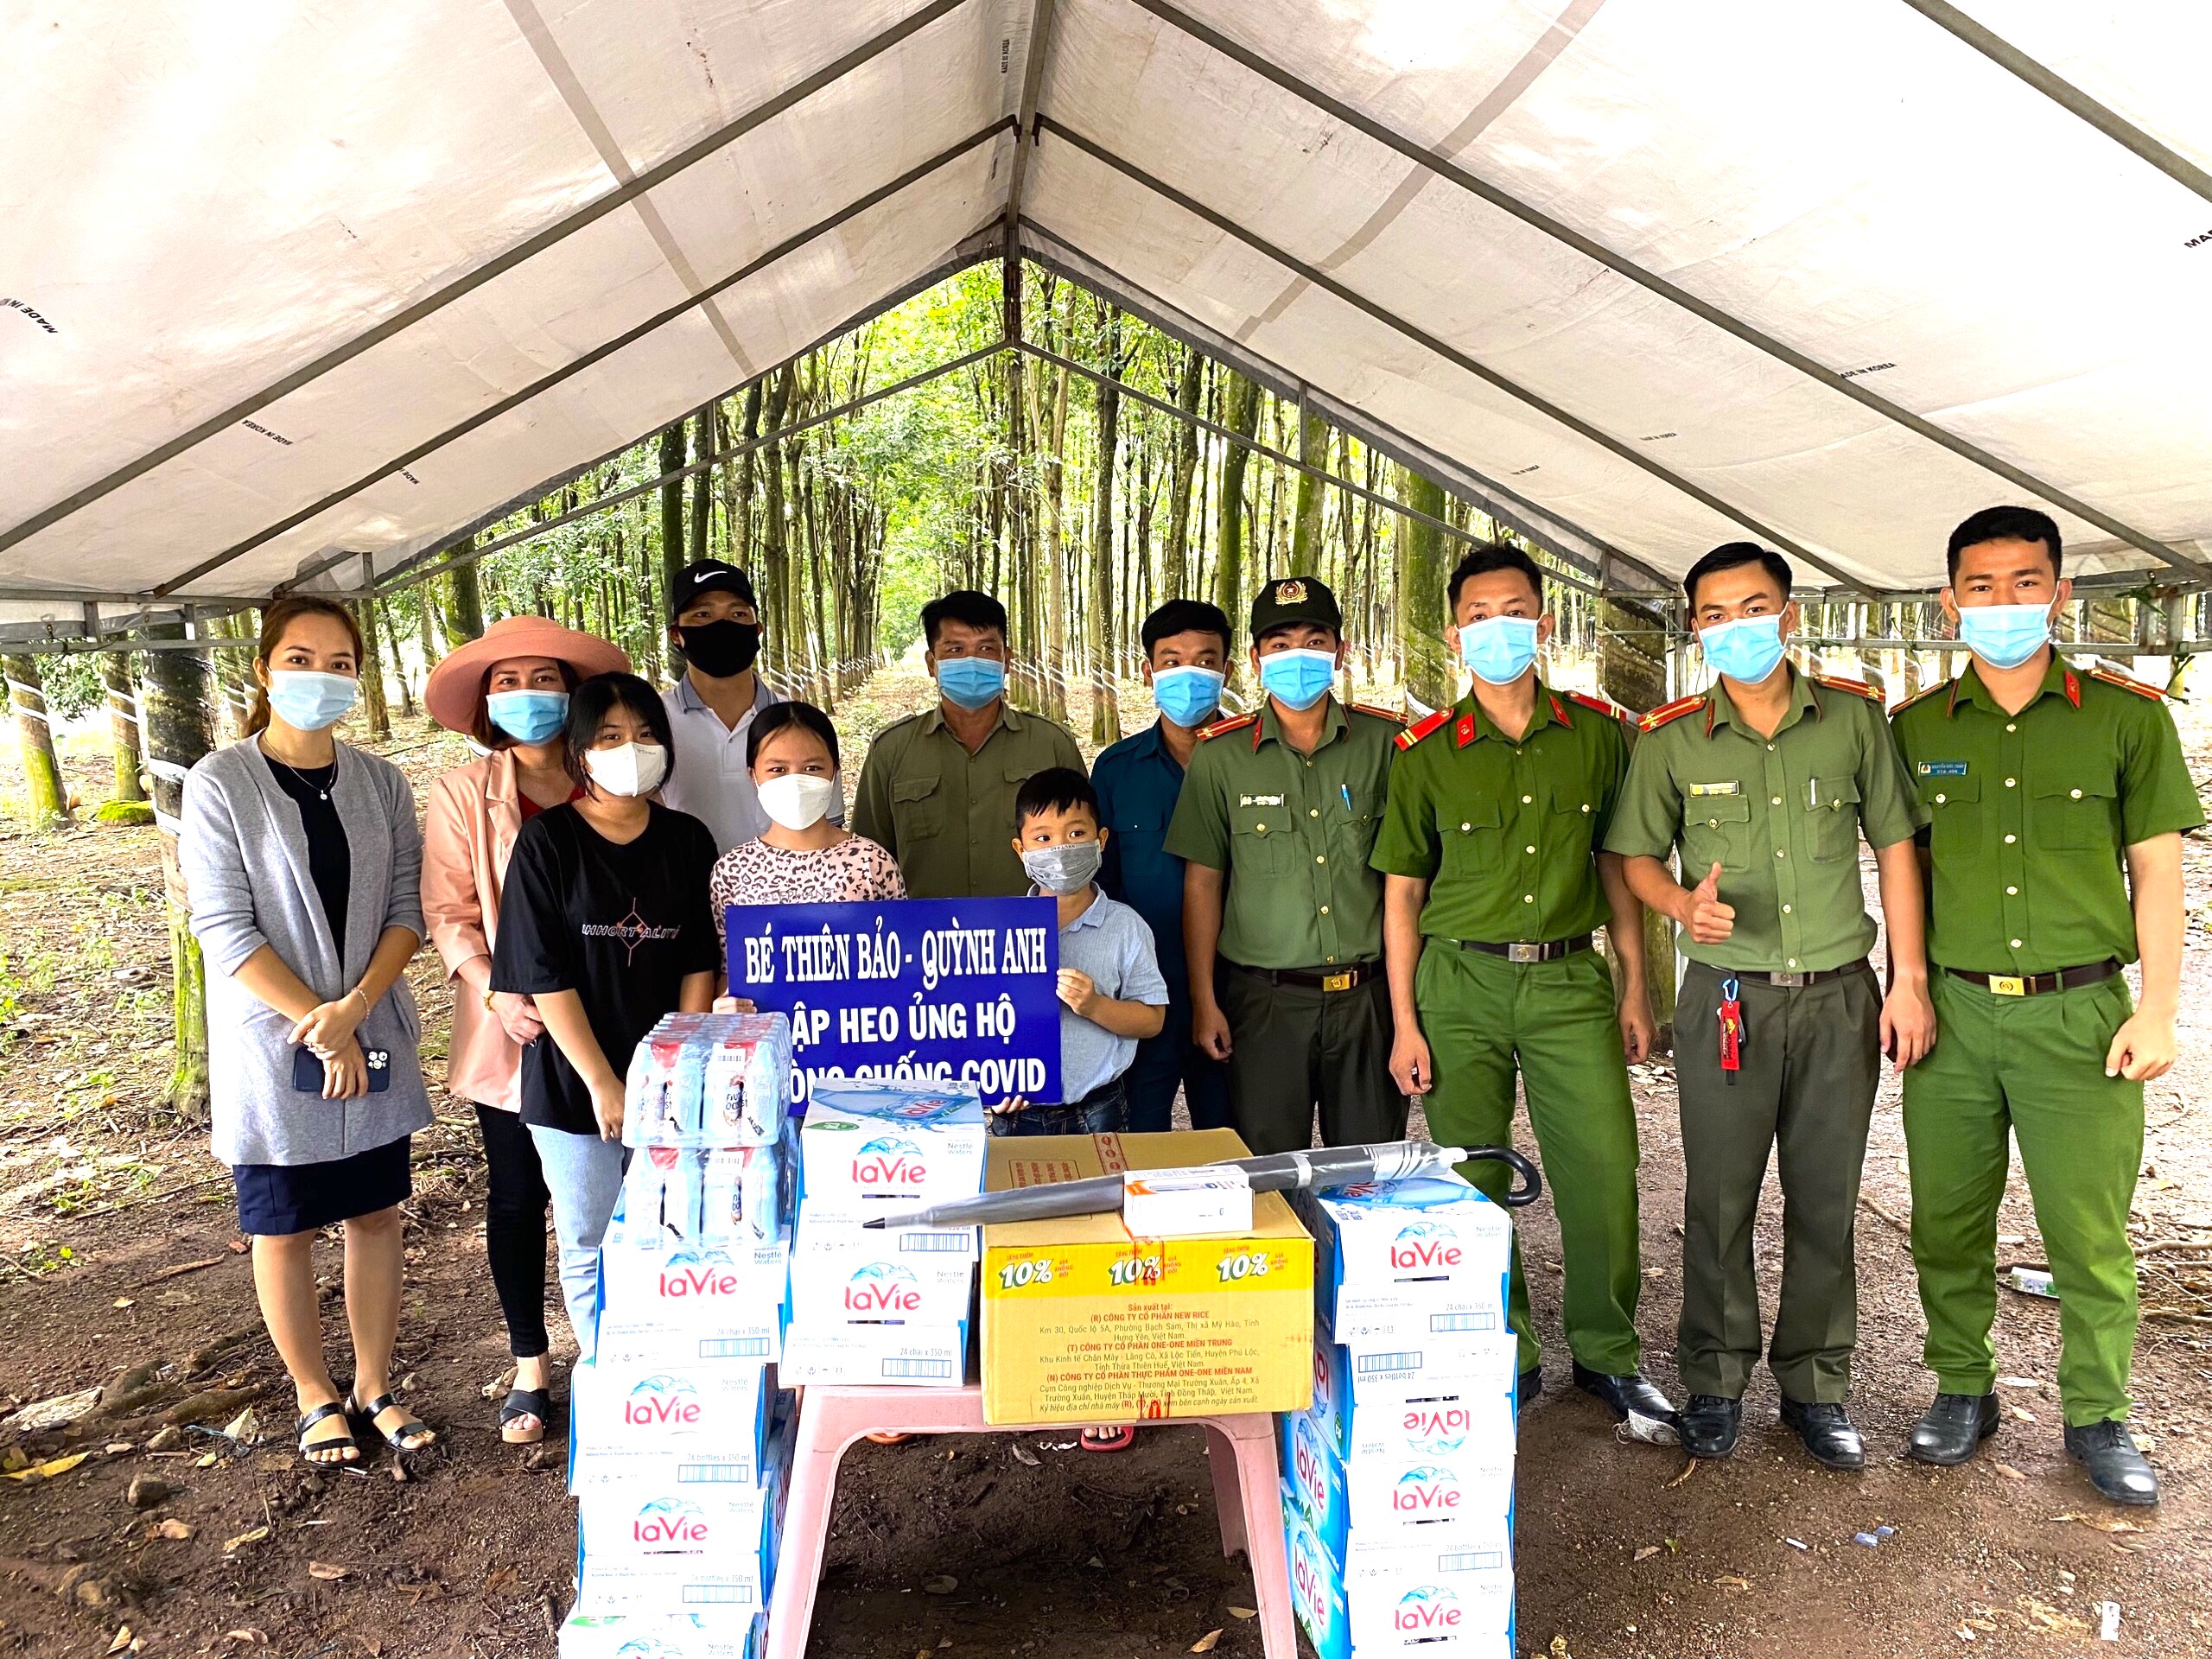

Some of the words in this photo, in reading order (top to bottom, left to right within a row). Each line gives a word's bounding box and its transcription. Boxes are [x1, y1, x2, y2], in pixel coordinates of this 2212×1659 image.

[20, 307, 59, 333] MADE
[1840, 371, 1859, 379] ADE
[1866, 362, 1897, 372] KOREA
[242, 419, 268, 433] KOREA
[272, 435, 294, 445] MADE
[402, 471, 420, 485] MADE
[745, 922, 774, 984] BÉ
[781, 923, 851, 983] THIÊN
[856, 915, 901, 980] BẢO
[905, 954, 912, 963] -
[921, 916, 996, 990] QUỲNH
[1001, 928, 1047, 975] ANH
[791, 1001, 830, 1054] ẬP
[840, 1005, 899, 1043] HEO
[909, 991, 968, 1040] ỦNG
[976, 993, 1015, 1044] HỘ
[961, 1058, 1046, 1095] COVID
[852, 1157, 926, 1183] laVie
[1391, 1241, 1462, 1268] laVie
[998, 1258, 1054, 1290] 10%
[1108, 1255, 1161, 1287] 10%
[1216, 1252, 1269, 1282] 10%
[660, 1268, 737, 1297] laVie
[845, 1283, 920, 1311] laVie
[1128, 1303, 1141, 1312] Sản
[1143, 1302, 1159, 1311] xuất
[1160, 1303, 1173, 1312] tại:
[1090, 1314, 1102, 1324] (R)
[1103, 1313, 1124, 1322] CÔNG
[1138, 1311, 1149, 1320] CỔ
[1151, 1311, 1172, 1320] PHẦN
[747, 1326, 760, 1335] 350
[761, 1326, 770, 1335] ml
[1054, 1326, 1065, 1335] 30,
[1068, 1325, 1087, 1333] Quốc
[1090, 1325, 1096, 1333] lộ
[1100, 1325, 1111, 1333] 5A,
[1115, 1324, 1141, 1333] Phường
[1145, 1323, 1163, 1332] Bạch
[1187, 1321, 1198, 1330] Thị
[1211, 1320, 1222, 1329] Mỹ
[1152, 1332, 1166, 1340] Việt
[900, 1347, 907, 1356] 24
[931, 1348, 943, 1357] 350
[1067, 1344, 1077, 1354] (T)
[1080, 1342, 1102, 1351] CÔNG
[1115, 1341, 1126, 1351] CỔ
[1128, 1340, 1149, 1350] PHẦN
[1151, 1340, 1185, 1349] ONE-ONE
[1186, 1338, 1205, 1348] MIỀN
[1083, 1353, 1102, 1362] Chân
[1103, 1353, 1119, 1362] Mây
[1125, 1352, 1143, 1362] Lăng
[1145, 1351, 1157, 1360] Cô,
[1186, 1349, 1203, 1358] Tiến,
[1205, 1349, 1227, 1358] Huyện
[1229, 1348, 1243, 1357] Phú
[1244, 1348, 1260, 1357] Lộc,
[1112, 1361, 1130, 1370] Thừa
[1132, 1361, 1152, 1370] Thiên
[1154, 1360, 1170, 1370] Huế,
[1171, 1359, 1185, 1368] Việt
[1046, 1374, 1058, 1383] (N)
[1060, 1372, 1082, 1382] CÔNG
[1084, 1372, 1094, 1381] TY
[1095, 1370, 1106, 1380] CỔ
[1108, 1370, 1129, 1379] PHẦN
[1131, 1370, 1153, 1380] THỰC
[1154, 1368, 1177, 1378] PHẨM
[1179, 1368, 1212, 1376] ONE-ONE
[1214, 1366, 1233, 1376] MIỀN
[1235, 1366, 1253, 1375] NAM
[1357, 1376, 1365, 1384] ml
[1367, 1374, 1377, 1383] 350
[1385, 1372, 1407, 1381] bottles
[1408, 1371, 1415, 1380] 24
[1039, 1384, 1056, 1393] Cụm
[1058, 1383, 1077, 1393] Công
[1078, 1382, 1103, 1392] nghiệp
[1104, 1382, 1121, 1391] Dịch
[1122, 1382, 1132, 1390] Vụ
[1138, 1380, 1166, 1389] Thương
[1166, 1379, 1180, 1388] Mại
[1182, 1378, 1207, 1388] Trường
[1209, 1377, 1229, 1387] Xuân,
[1230, 1376, 1241, 1385] Ấp
[1249, 1376, 1260, 1384] Xã
[1045, 1393, 1071, 1403] Trường
[1072, 1392, 1092, 1402] Xuân,
[1094, 1392, 1116, 1402] Huyện
[1118, 1390, 1136, 1400] Tháp
[1138, 1390, 1159, 1399] Mười,
[1177, 1388, 1196, 1398] Đồng
[1198, 1387, 1217, 1396] Tháp,
[1220, 1387, 1235, 1395] Việt
[626, 1396, 701, 1425] laVie
[1039, 1404, 1049, 1414] Ký
[1049, 1403, 1065, 1413] hiệu
[1066, 1402, 1077, 1412] địa
[1078, 1401, 1090, 1411] chỉ
[1090, 1401, 1104, 1410] nhà
[1105, 1401, 1121, 1411] máy
[1122, 1400, 1135, 1410] (R),
[1179, 1397, 1192, 1407] bên
[1193, 1397, 1210, 1406] cạnh
[1211, 1397, 1228, 1407] ngày
[1229, 1395, 1242, 1405] sản
[1402, 1410, 1470, 1437] laVie
[696, 1453, 721, 1462] bottles
[728, 1453, 740, 1462] 350
[741, 1453, 750, 1462] ml
[1296, 1433, 1325, 1510] laVie
[1393, 1484, 1461, 1511] laVie
[634, 1516, 708, 1542] laVie
[744, 1574, 753, 1583] ml
[1294, 1542, 1325, 1625] laVie
[1395, 1604, 1461, 1630] laVie
